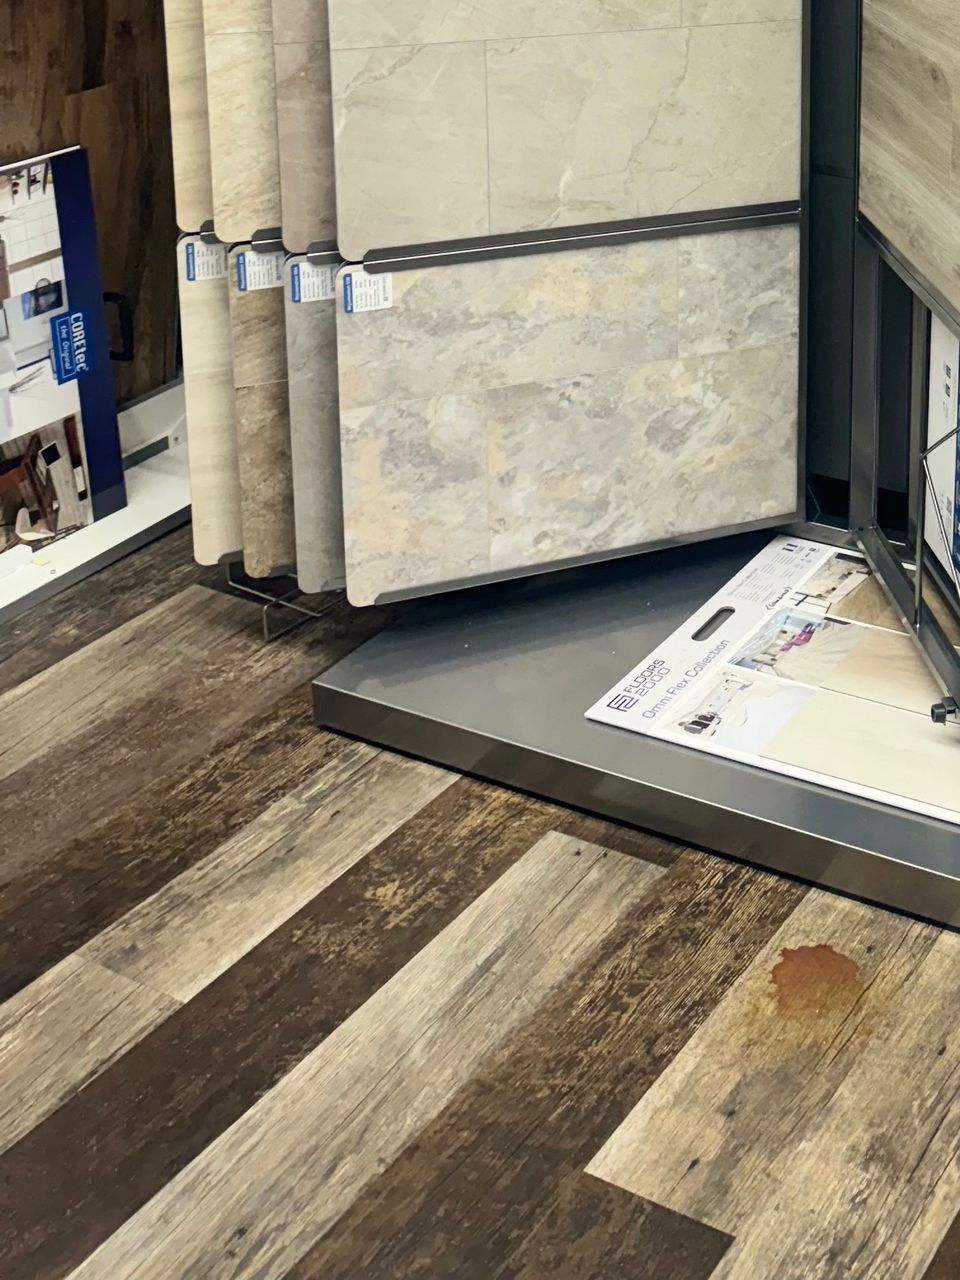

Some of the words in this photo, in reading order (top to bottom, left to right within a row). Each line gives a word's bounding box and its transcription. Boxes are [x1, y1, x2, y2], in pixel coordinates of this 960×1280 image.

[60, 325, 68, 339] the
[70, 312, 87, 372] COREtec
[61, 341, 73, 370] Original
[623, 658, 665, 694] FLOORS
[634, 667, 671, 697] 2000
[642, 694, 674, 719] Omni
[668, 677, 690, 699] Flex
[686, 639, 731, 678] Collection
